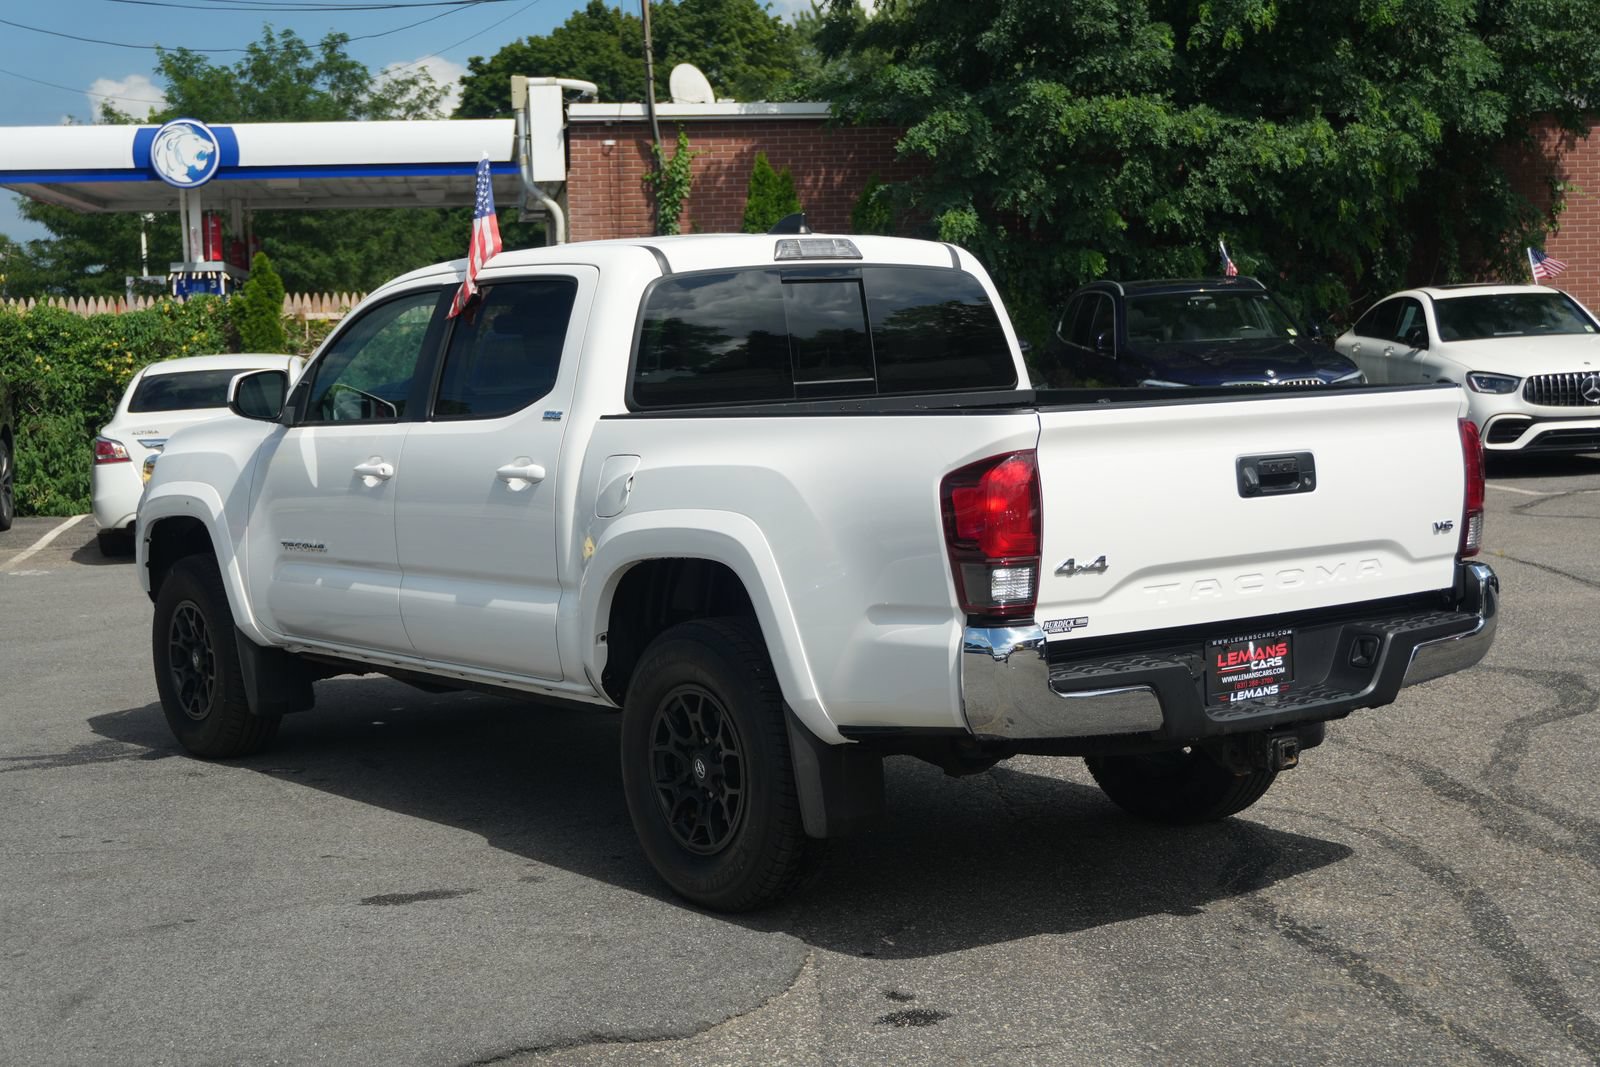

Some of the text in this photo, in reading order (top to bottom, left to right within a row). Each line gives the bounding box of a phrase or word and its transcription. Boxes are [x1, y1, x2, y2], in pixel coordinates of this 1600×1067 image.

[209, 280, 218, 289] 3
[1432, 520, 1454, 533] V6
[280, 541, 326, 551] TACOMA
[1143, 558, 1383, 605] TACOMA
[1043, 618, 1075, 630] BURDICK
[1212, 629, 1292, 646] WWW.LEMANSCARS.COM
[1217, 642, 1288, 667] LEMANS
[1250, 656, 1284, 670] CARS
[1221, 667, 1286, 684] WWW.LEMANSCARS.COM
[1229, 684, 1279, 702] LEMANS
